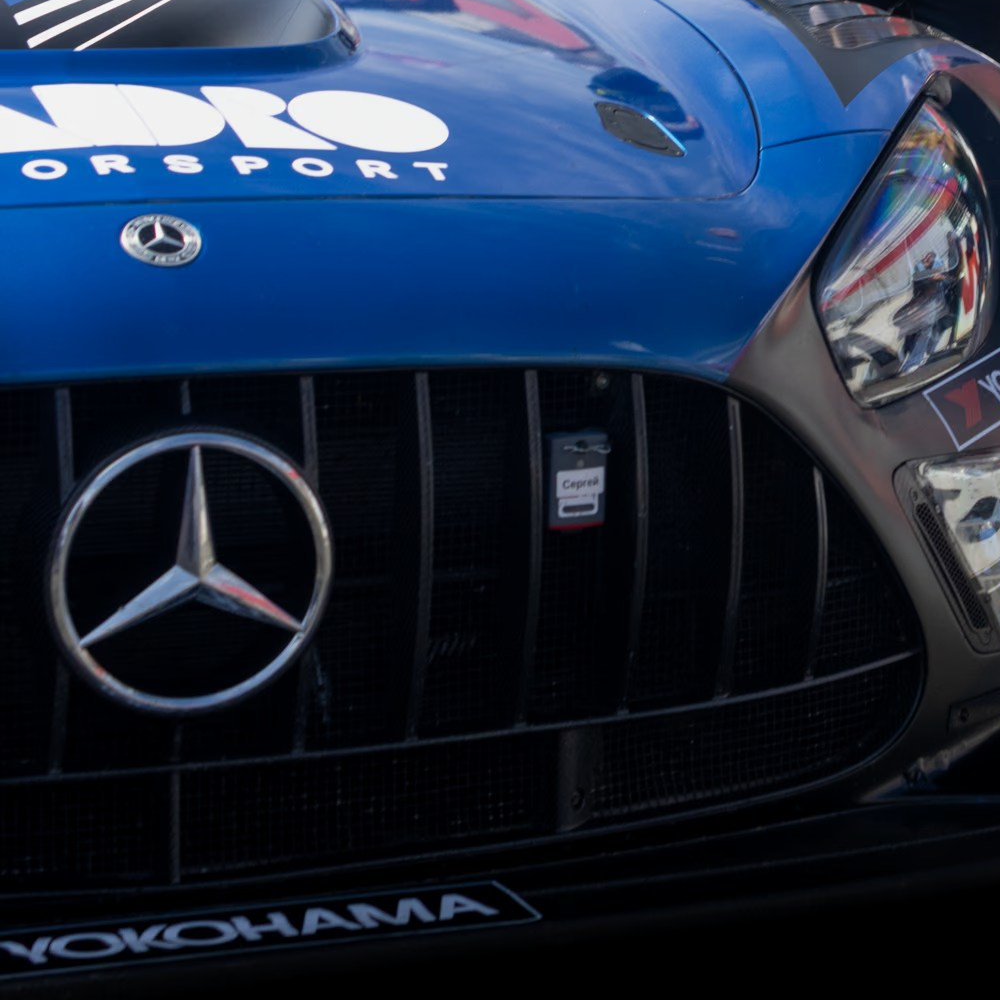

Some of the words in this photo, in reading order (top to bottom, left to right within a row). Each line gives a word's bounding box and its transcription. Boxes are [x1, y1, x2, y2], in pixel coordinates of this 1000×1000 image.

[21, 153, 449, 181] ORSPORT
[562, 475, 600, 491] Сергей
[0, 893, 499, 964] YOKOHAMA
